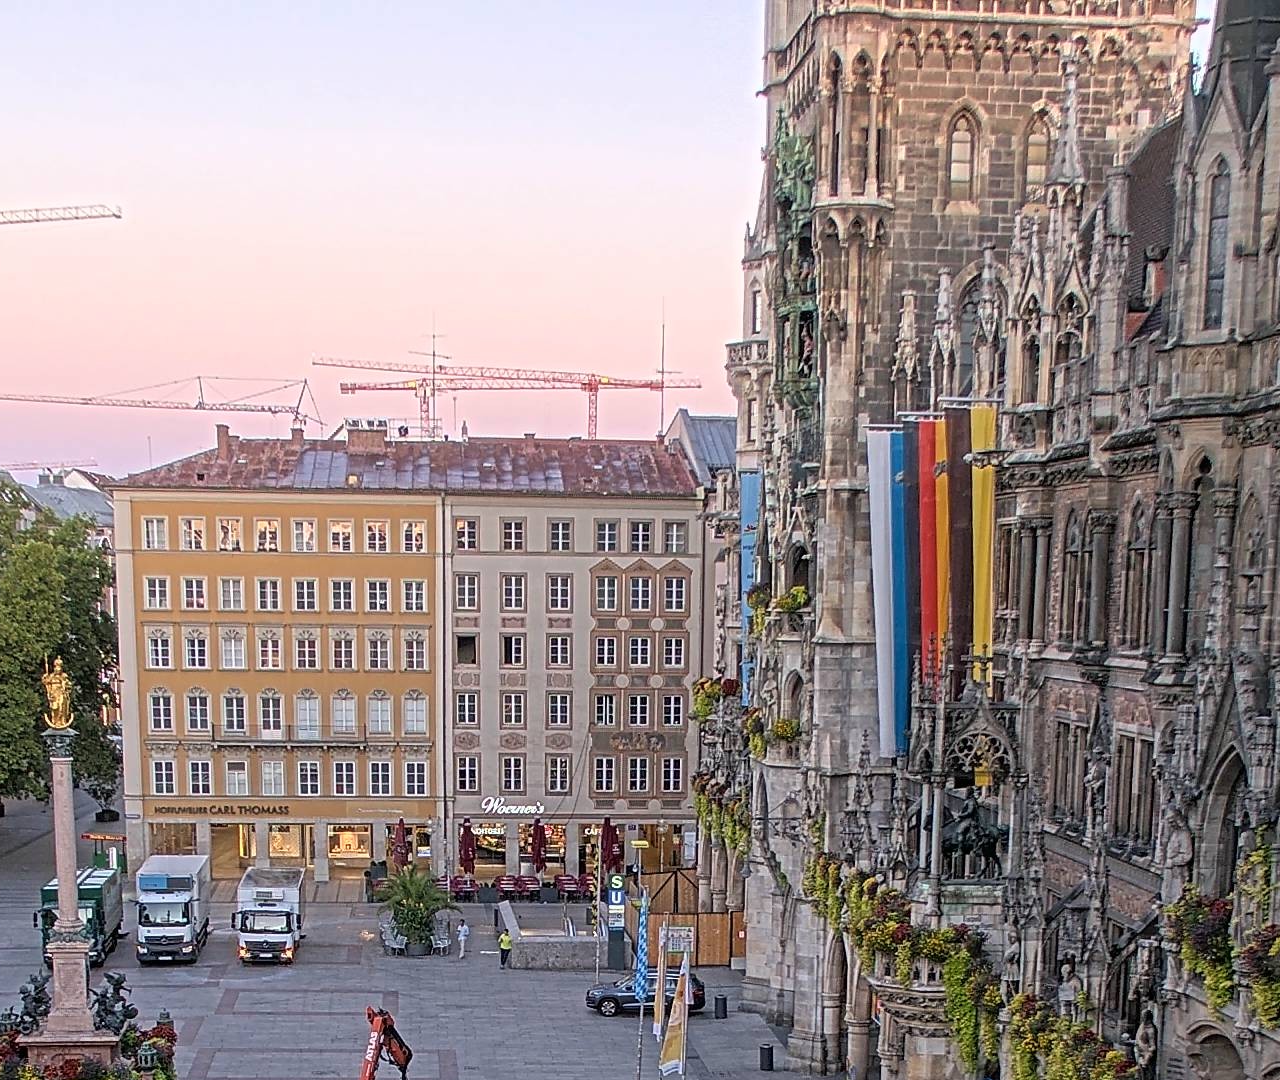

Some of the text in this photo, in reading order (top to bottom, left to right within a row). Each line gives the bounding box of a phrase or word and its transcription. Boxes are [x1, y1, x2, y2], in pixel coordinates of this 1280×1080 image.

[209, 805, 236, 815] CARL
[238, 805, 290, 816] THOMASS
[481, 796, 545, 815] Woerner's
[611, 875, 623, 889] S
[611, 891, 622, 904] U
